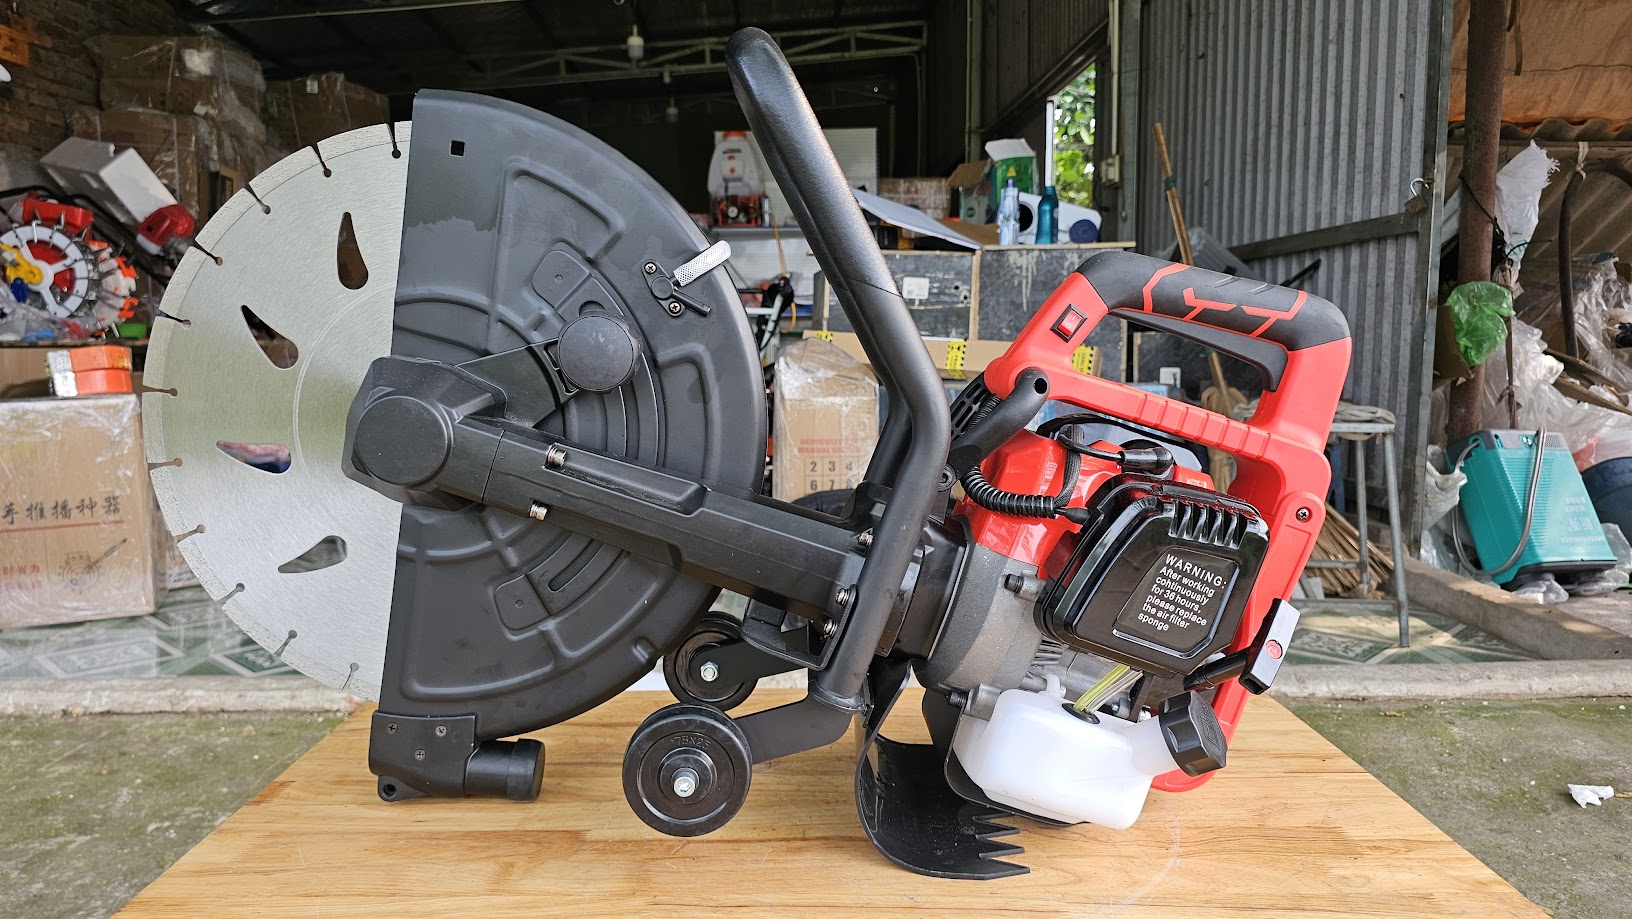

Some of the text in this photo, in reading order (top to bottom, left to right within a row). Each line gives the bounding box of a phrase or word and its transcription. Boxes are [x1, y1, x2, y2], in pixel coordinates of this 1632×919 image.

[810, 461, 817, 472] 2
[828, 461, 836, 472] 3
[810, 480, 818, 491] 6
[829, 480, 835, 491] 7
[1160, 566, 1215, 598] After working
[1165, 554, 1227, 589] WARNING:
[1146, 595, 1207, 626] please replace
[1151, 584, 1201, 613] for 36 hours,
[1138, 613, 1169, 631] sponge
[1142, 603, 1190, 629] the air filter
